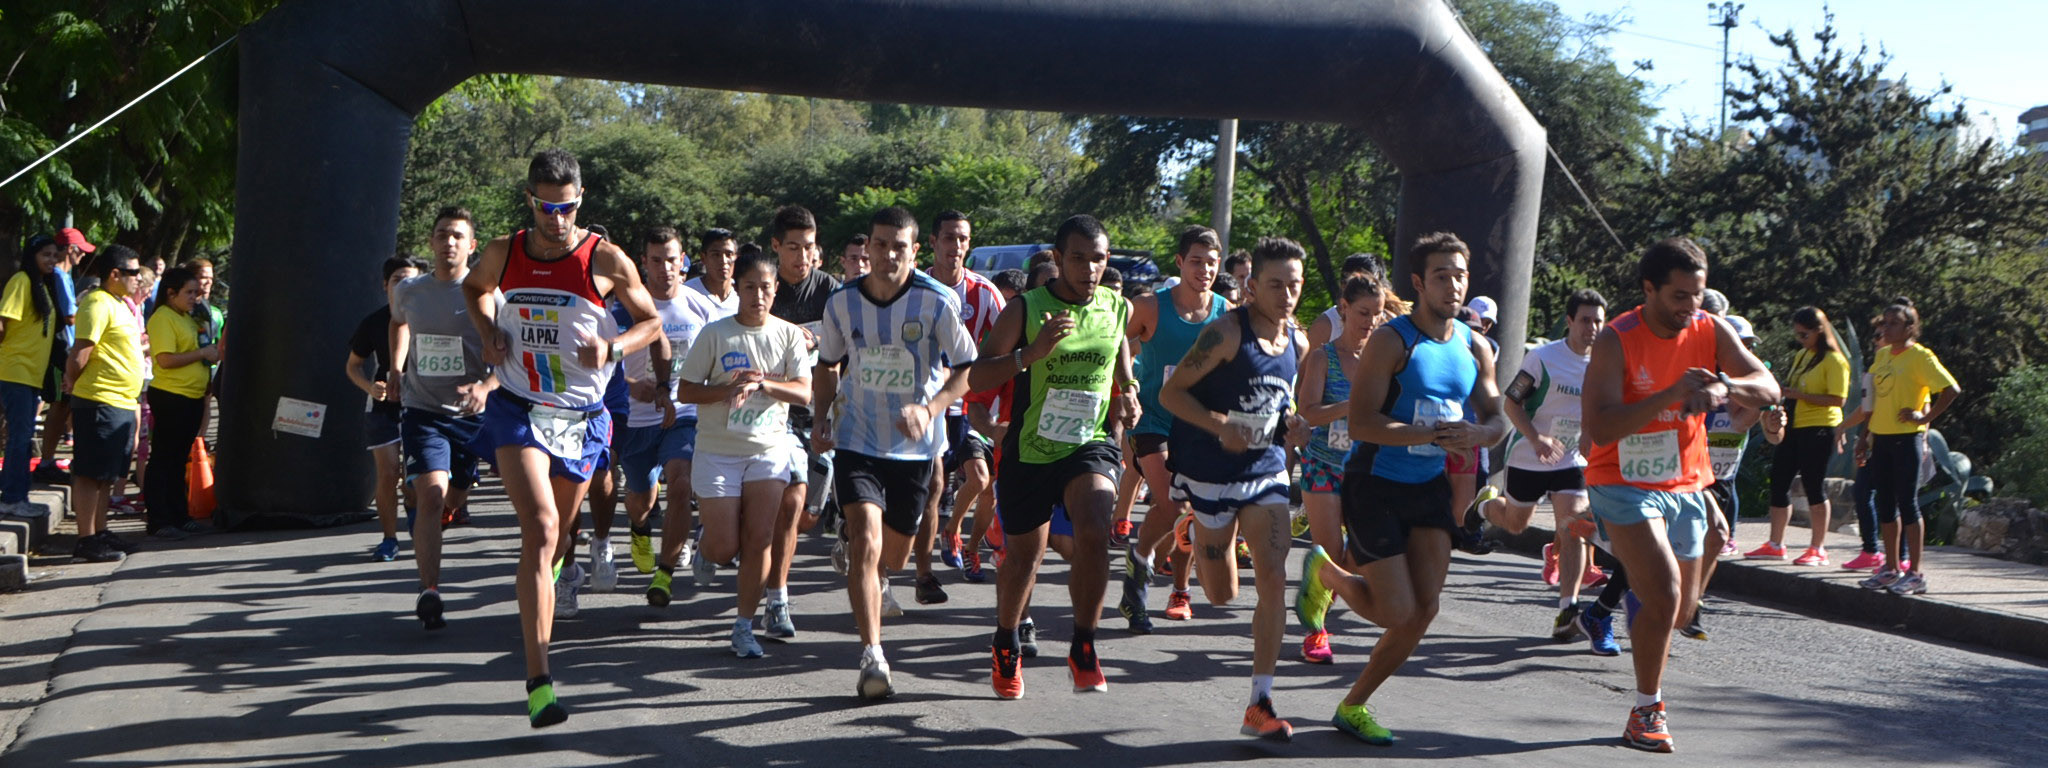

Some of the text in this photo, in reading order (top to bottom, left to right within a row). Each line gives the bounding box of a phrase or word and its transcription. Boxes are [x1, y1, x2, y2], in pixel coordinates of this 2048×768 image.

[521, 326, 559, 345] LA PAZ
[662, 322, 696, 332] Macro
[418, 355, 463, 371] 4635
[861, 367, 914, 387] 3725
[729, 407, 776, 427] 4655
[1621, 453, 1679, 479] 4654
